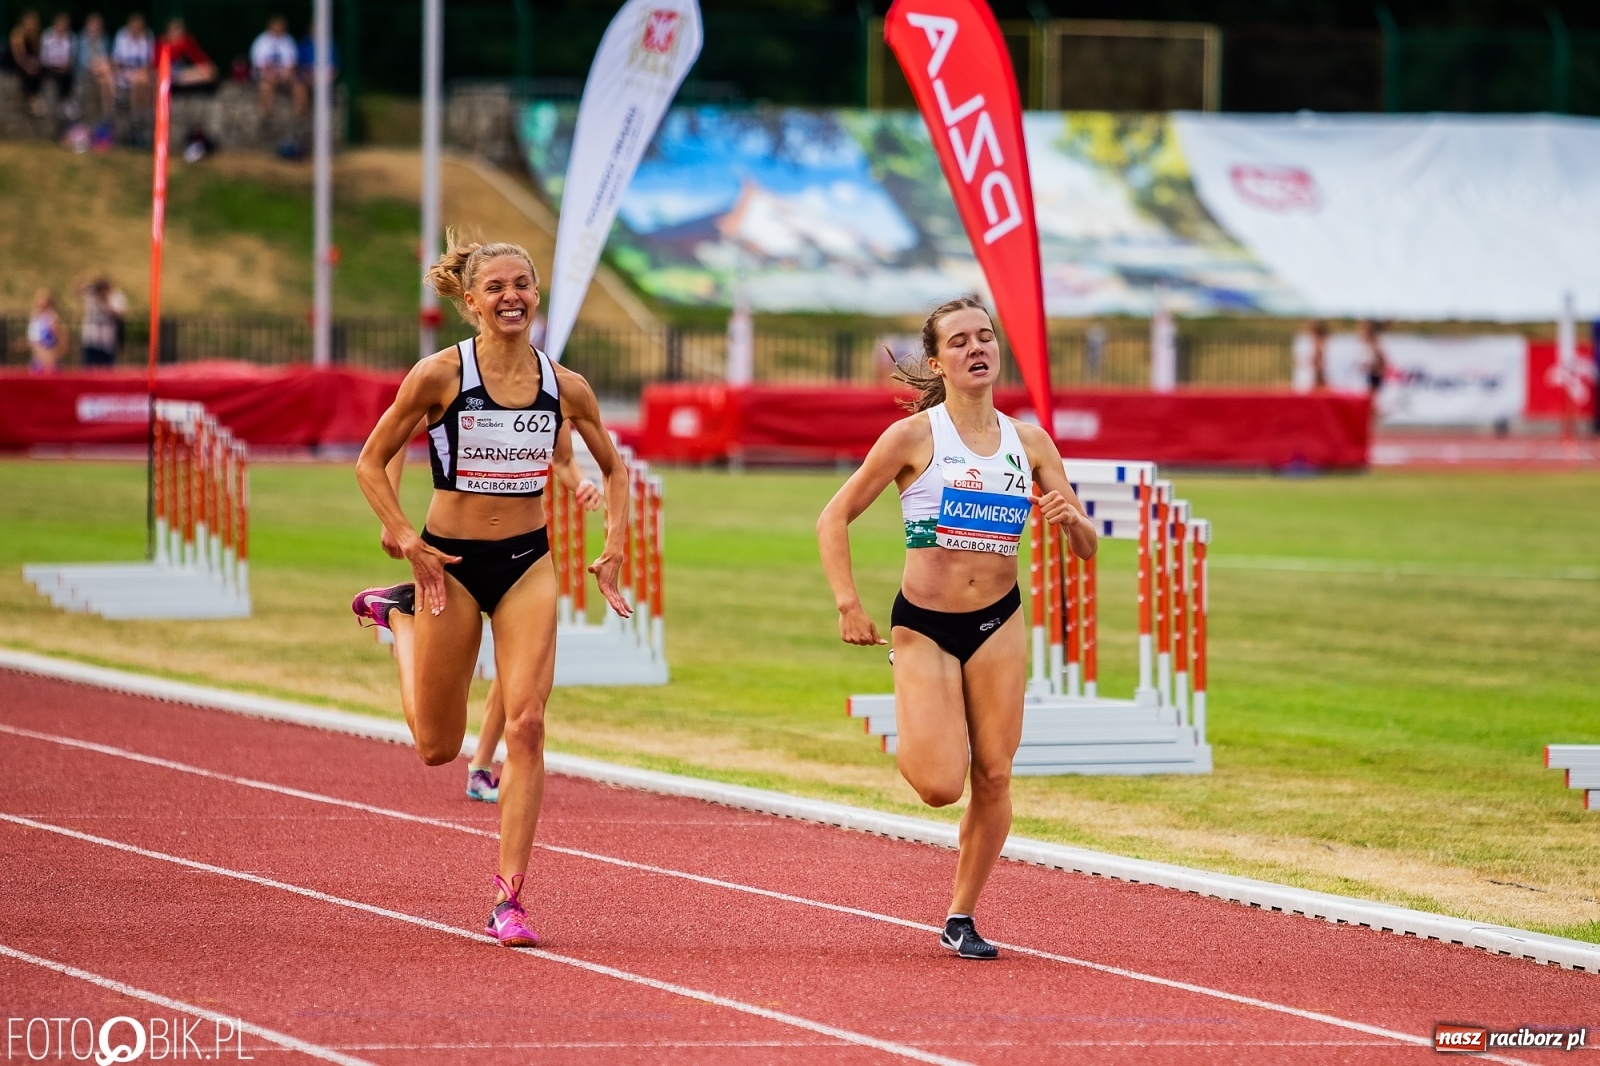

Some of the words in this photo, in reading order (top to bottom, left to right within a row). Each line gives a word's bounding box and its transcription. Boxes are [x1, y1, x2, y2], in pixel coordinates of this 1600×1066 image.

[513, 414, 551, 433] 662
[462, 447, 547, 461] SARNECKA
[467, 480, 517, 491] RACIBÓRZ
[519, 480, 538, 490] 2019
[955, 481, 982, 489] ORLEN
[1003, 472, 1027, 494] 74
[943, 499, 1028, 524] KAZIMIERSKA
[946, 538, 997, 552] RACIBÓRZ
